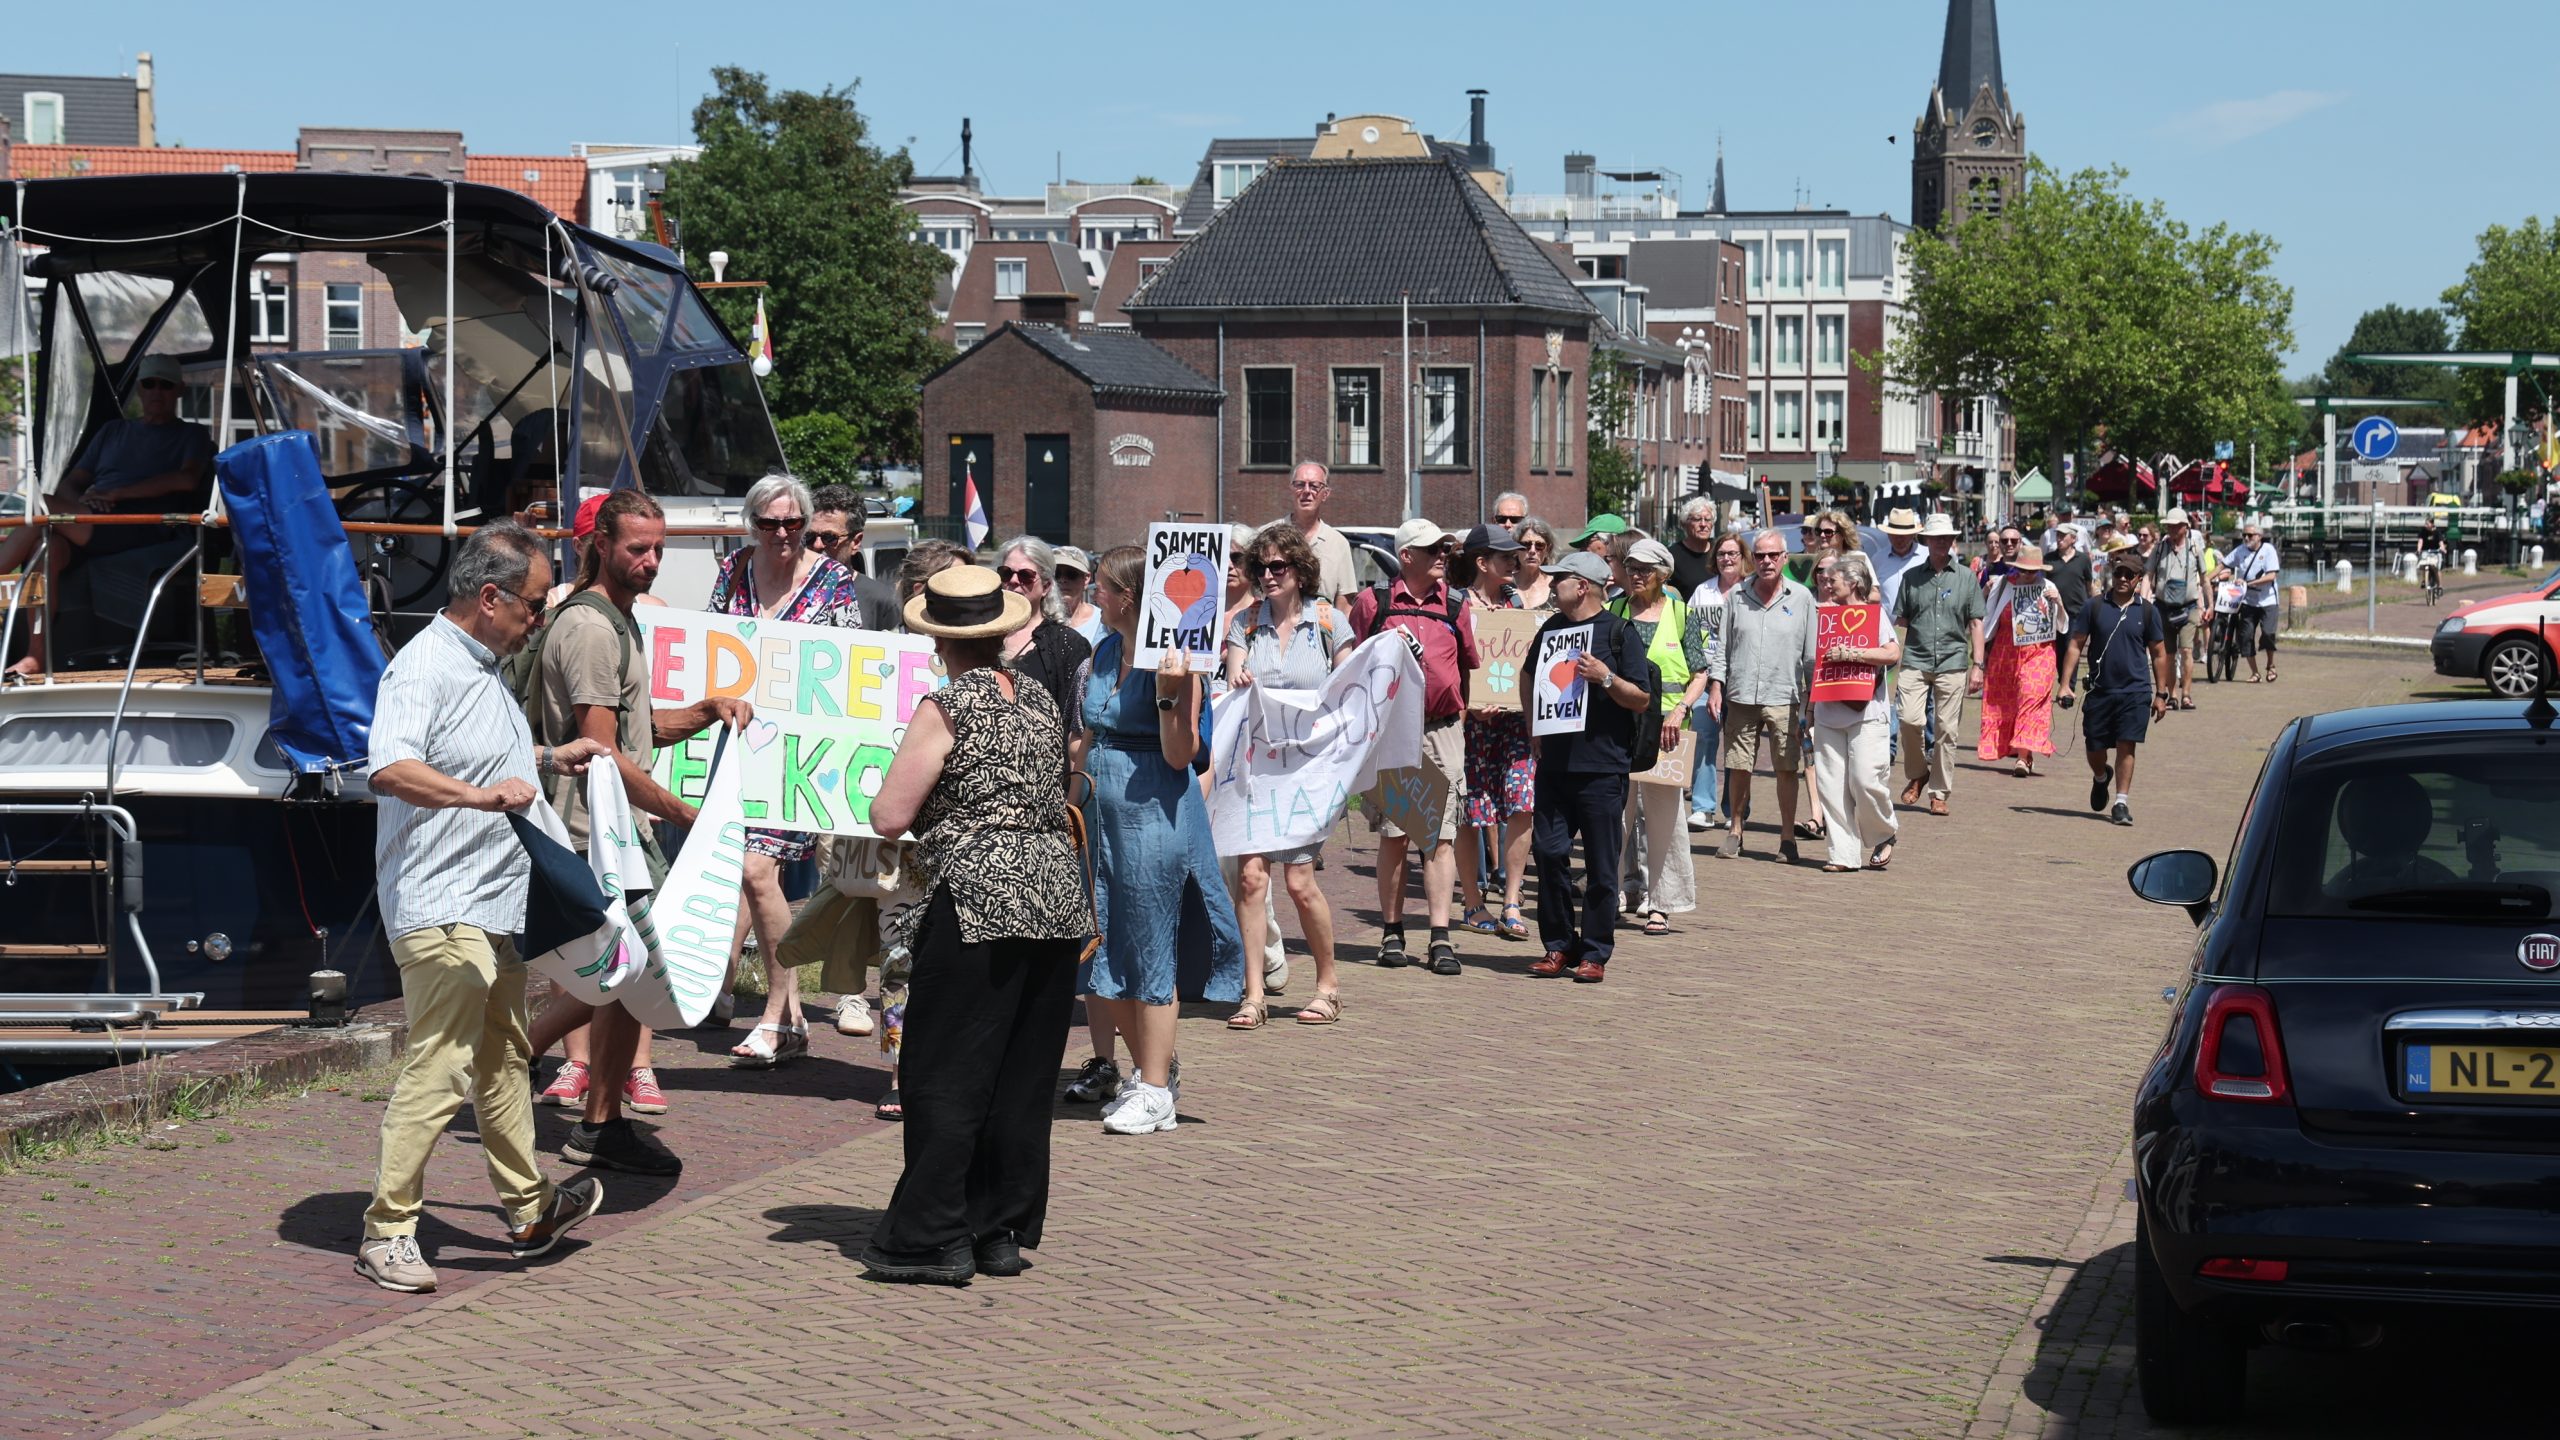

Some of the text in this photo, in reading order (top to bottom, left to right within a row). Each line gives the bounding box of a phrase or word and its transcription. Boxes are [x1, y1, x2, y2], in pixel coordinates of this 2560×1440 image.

[1153, 531, 1223, 571] SAMEN
[1145, 611, 1216, 651] LEVEN
[1819, 613, 1838, 635] DE
[2016, 632, 2054, 643] GEEN HAAT
[1543, 630, 1589, 663] SAMEN
[1818, 634, 1869, 649] WERELD
[638, 623, 949, 723] EDEREE
[1537, 686, 1585, 720] LEVEN
[2529, 943, 2556, 960] FIAT
[2409, 1074, 2427, 1085] NL
[2450, 1051, 2556, 1089] NL-2
